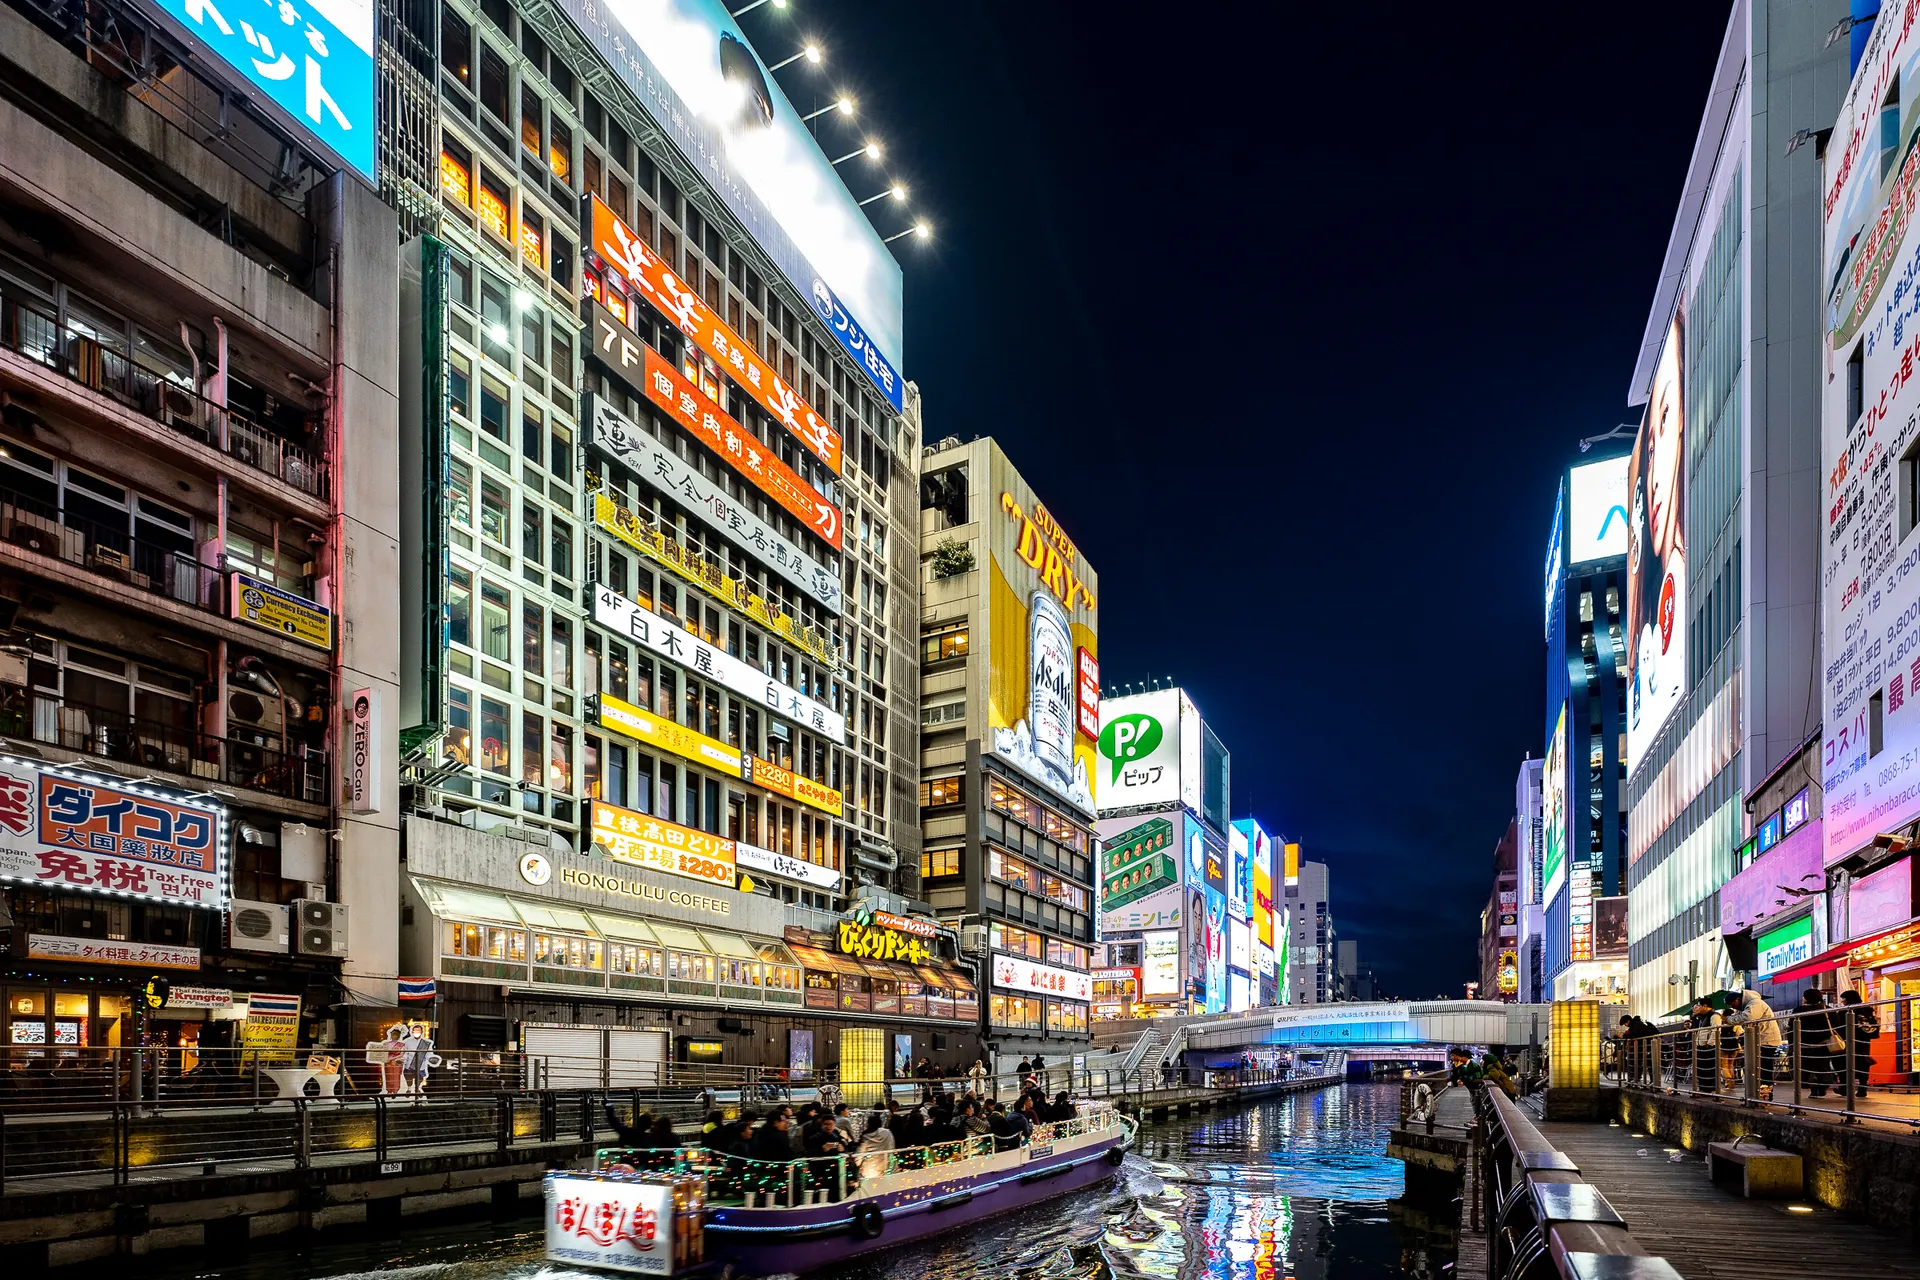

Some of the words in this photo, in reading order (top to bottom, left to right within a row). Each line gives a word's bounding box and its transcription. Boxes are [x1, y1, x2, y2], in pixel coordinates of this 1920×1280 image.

[1826, 0, 1920, 225] 日本原カンツリー倶
[1854, 134, 1920, 292] 新規会員募
[598, 318, 640, 369] 7F
[602, 219, 704, 336] 笑笑
[766, 375, 836, 462] 笑笑
[833, 303, 894, 393] フジ住宅
[652, 370, 763, 477] 個室肉割烹
[815, 503, 837, 539] 刀
[653, 452, 806, 582] 完全個室居酒屋
[1861, 472, 1891, 530] 5,200円
[1035, 504, 1075, 564] SUPER
[1841, 576, 1859, 611] 土日祝
[1861, 523, 1892, 577] 7,800円
[266, 596, 296, 613] Currency
[297, 607, 326, 625] Exchange
[1845, 608, 1864, 642] ロッジ
[1887, 543, 1920, 594] 3,780
[1866, 637, 1881, 665] 平日
[1887, 597, 1920, 644] 9,800
[601, 593, 623, 611] 4F
[630, 609, 714, 677] 白木屋
[766, 681, 826, 734] 白木屋
[1866, 663, 1881, 690] 平日
[1883, 626, 1920, 675] 14,800
[1035, 654, 1071, 711] Asahi
[1049, 699, 1059, 718] 生
[355, 722, 365, 767] ZERO
[1825, 707, 1865, 767] コスパ
[1124, 766, 1163, 787] ピップ
[48, 783, 210, 848] ダイコク
[1830, 789, 1857, 821] 予約受付
[0, 848, 31, 857] apan.
[594, 808, 721, 857] 豊後高田どり
[720, 840, 735, 852] 2F
[0, 856, 36, 867] ax-free
[35, 850, 150, 893] 免税
[147, 868, 214, 890] Tax-Free
[688, 857, 727, 881] 280
[161, 883, 202, 900] 면세
[562, 869, 665, 901] HONOLULU
[669, 891, 730, 914] COFFEE
[876, 914, 936, 936] ハンバーグレストラン
[1129, 911, 1169, 928] ミント
[82, 945, 198, 966] タイ料理とタイスキの店
[840, 921, 930, 965] びっくりドンキー
[1766, 941, 1807, 970] FamilyMart
[174, 992, 231, 1002] Krungtep
[192, 988, 230, 996] Restaurant
[1031, 969, 1066, 992] かに道楽
[262, 1016, 297, 1026] RESTAURANT
